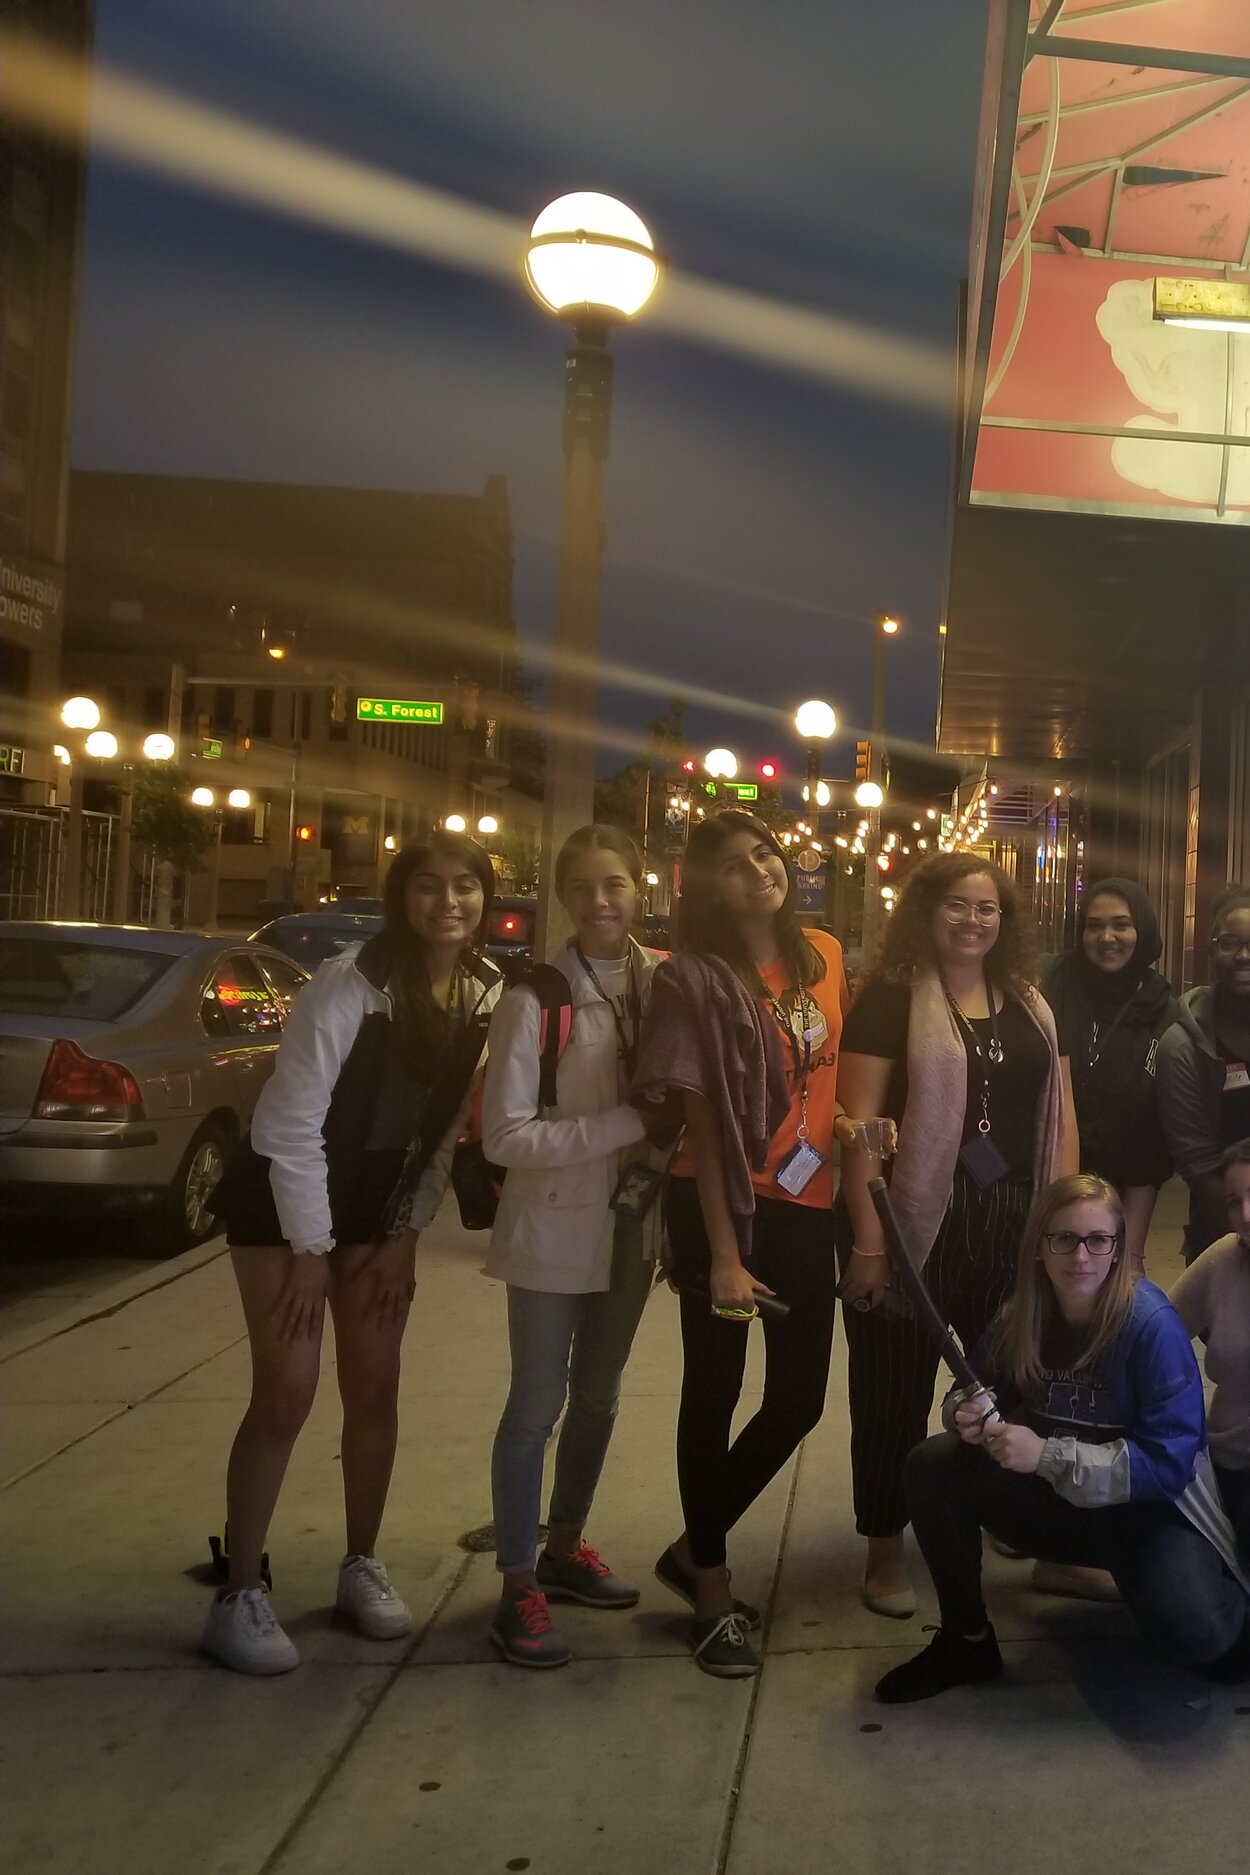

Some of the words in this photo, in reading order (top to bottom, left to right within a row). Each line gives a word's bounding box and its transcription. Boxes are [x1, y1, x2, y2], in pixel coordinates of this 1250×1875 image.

[374, 703, 387, 716] S.
[391, 704, 438, 719] Forest
[343, 816, 369, 834] M
